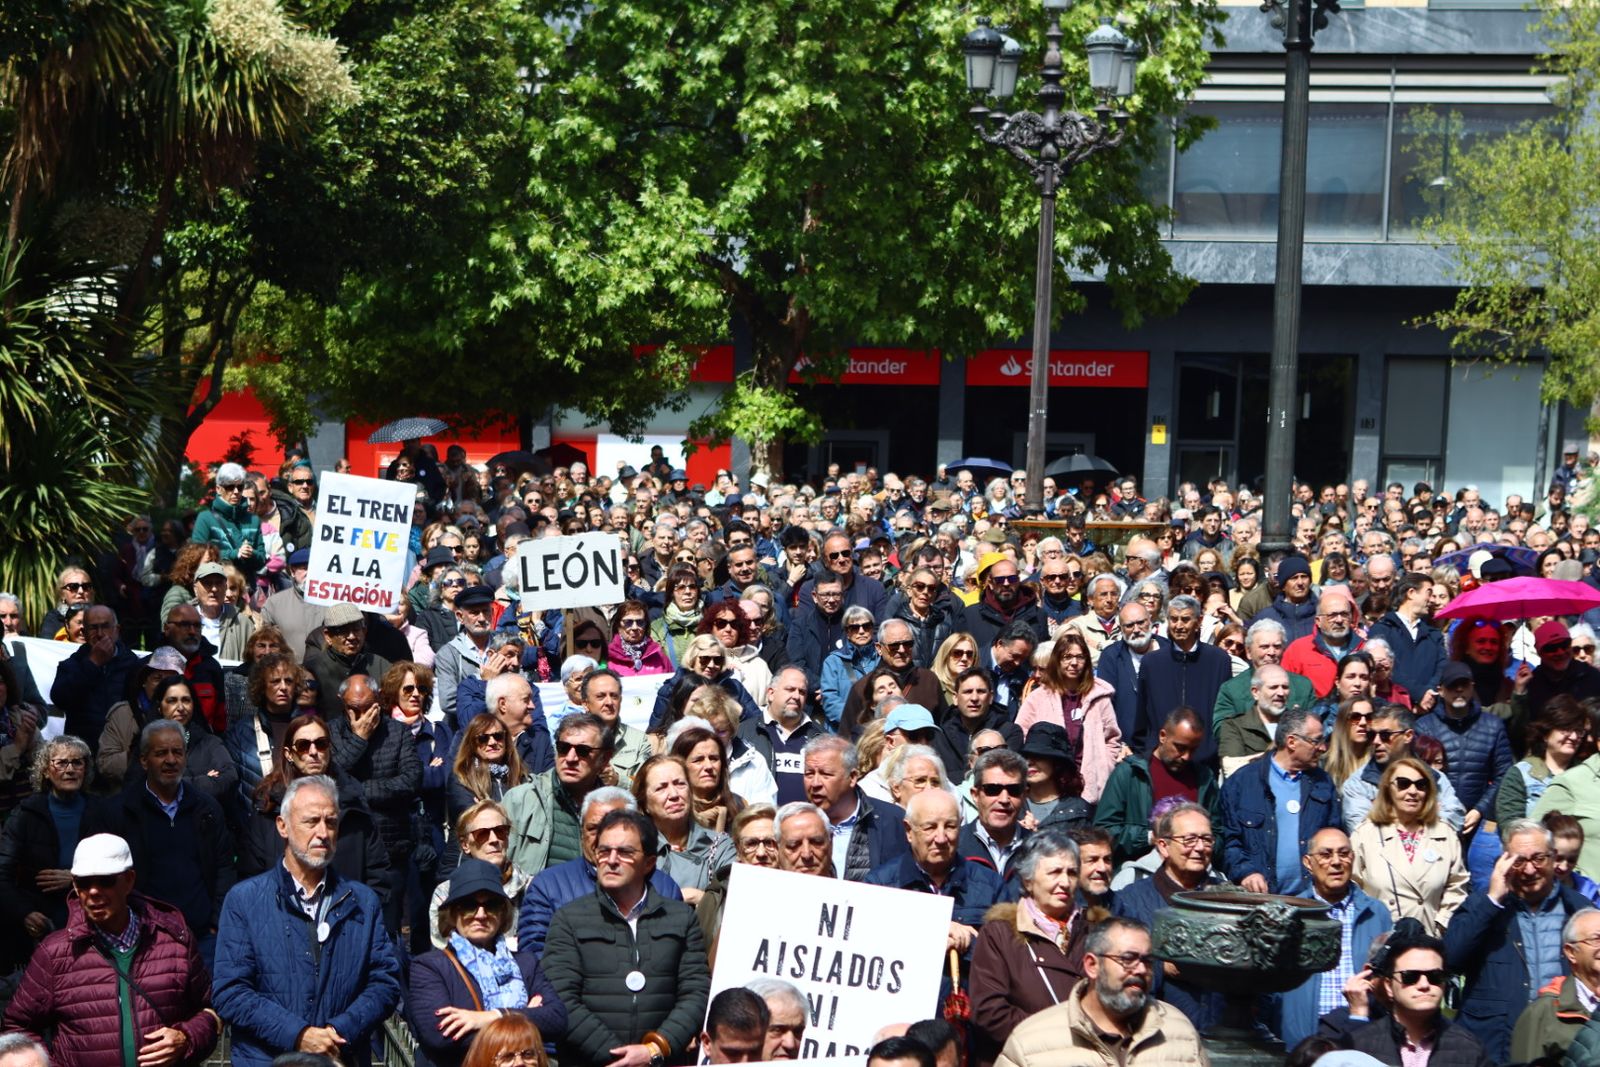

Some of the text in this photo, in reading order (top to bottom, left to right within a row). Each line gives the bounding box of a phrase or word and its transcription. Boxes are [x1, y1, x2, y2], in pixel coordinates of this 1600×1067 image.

[845, 359, 908, 375] tander
[1025, 360, 1115, 377] Sntander
[327, 494, 409, 524] EL TREN
[321, 524, 400, 553] DE FEVE
[327, 554, 382, 580] A LA
[520, 541, 619, 592] LEÓN
[818, 902, 854, 941] NI
[752, 938, 905, 994] AISLADOS
